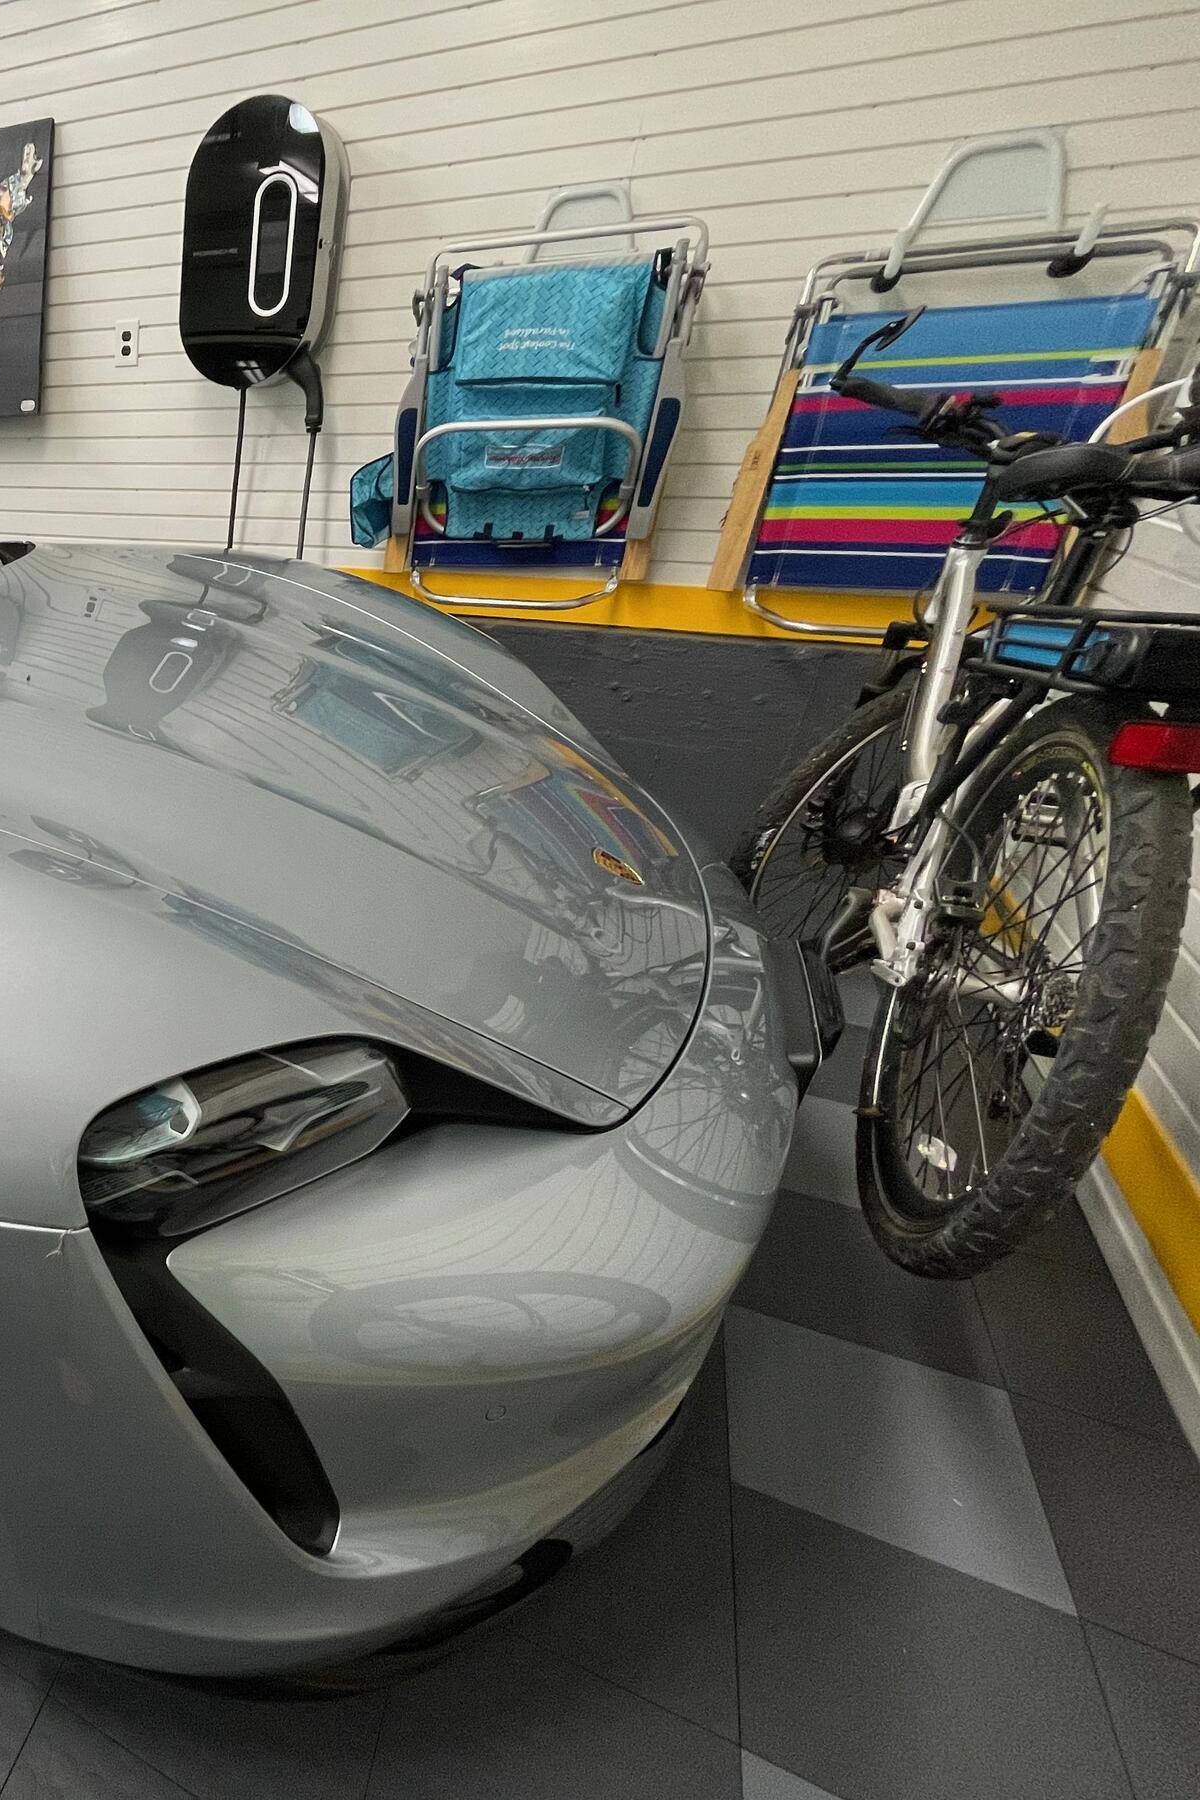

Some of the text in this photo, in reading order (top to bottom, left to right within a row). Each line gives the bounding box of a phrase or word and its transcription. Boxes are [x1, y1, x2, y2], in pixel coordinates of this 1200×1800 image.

[496, 339, 576, 352] The Coolest Spot
